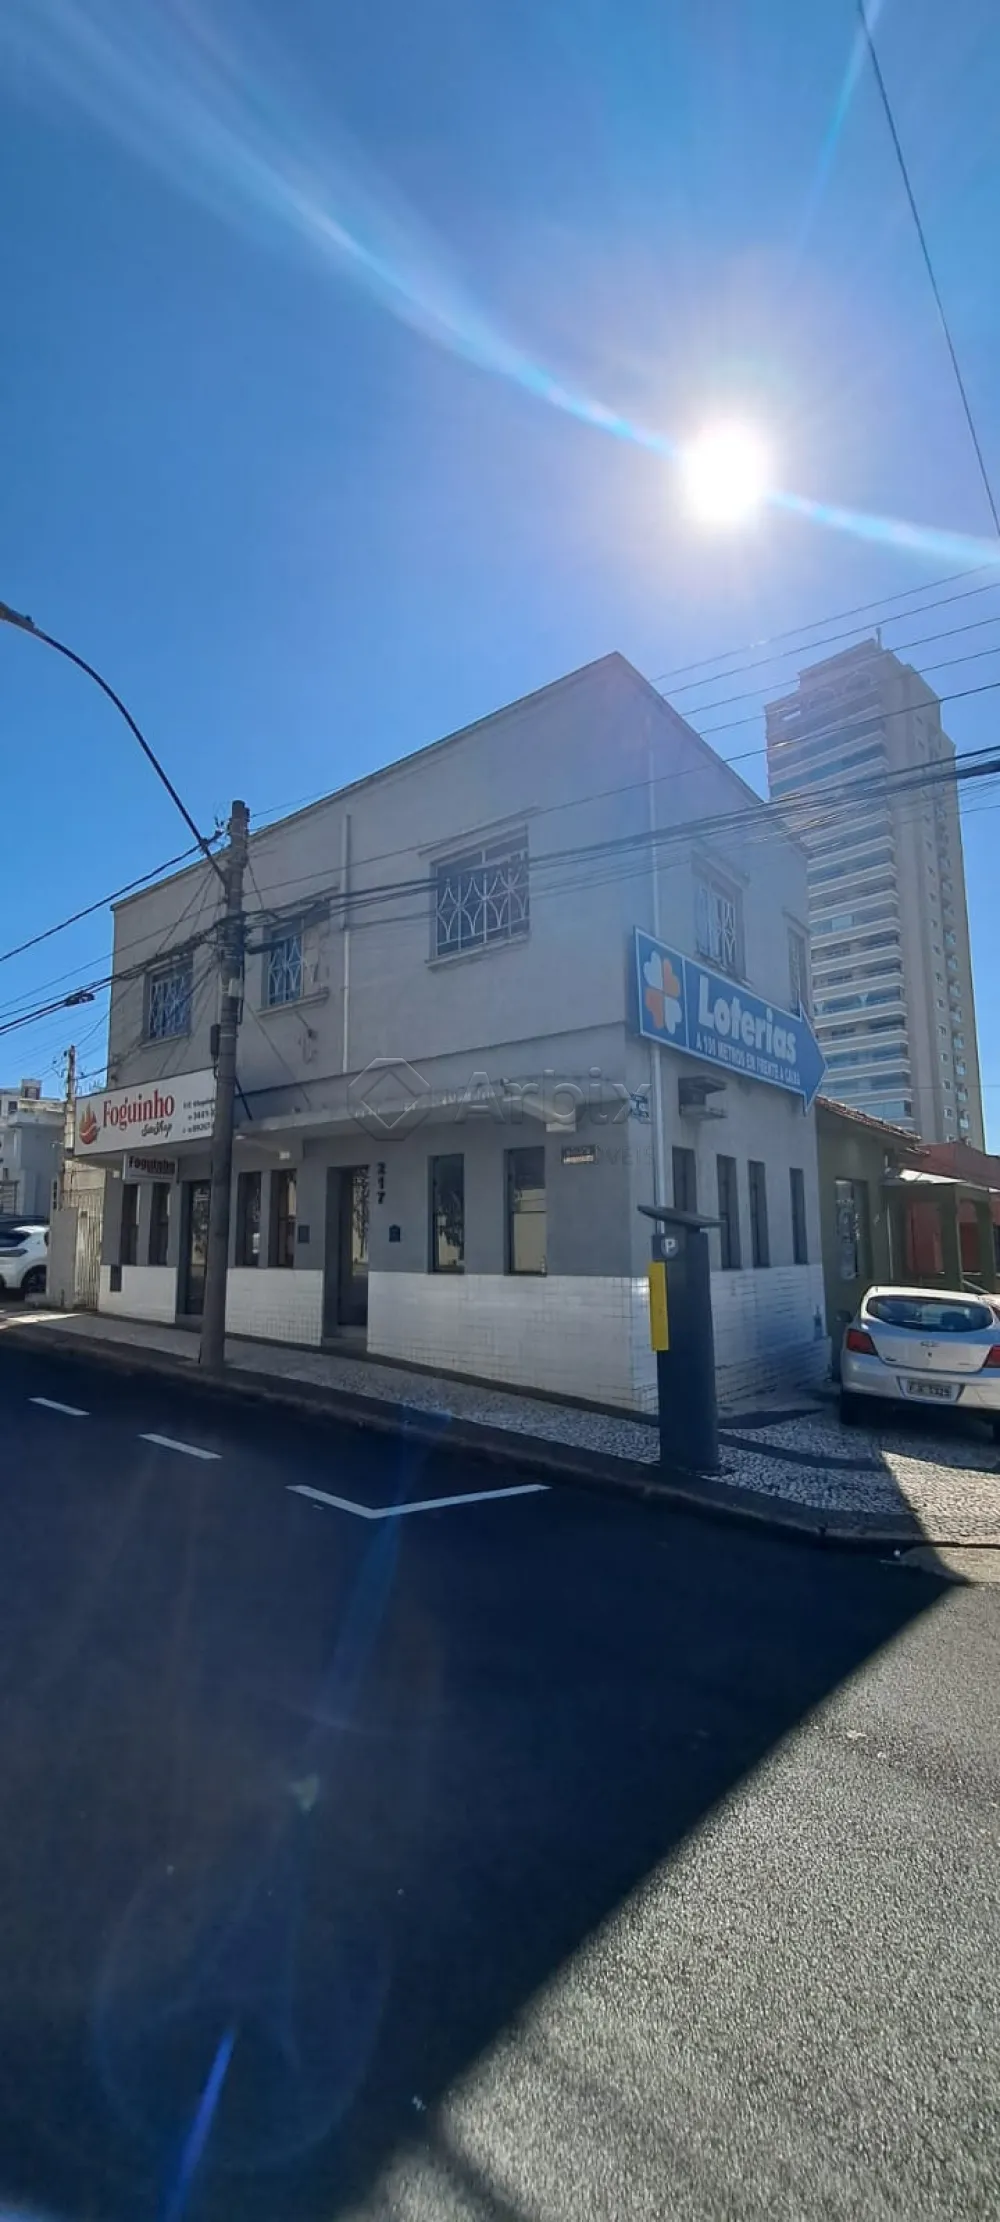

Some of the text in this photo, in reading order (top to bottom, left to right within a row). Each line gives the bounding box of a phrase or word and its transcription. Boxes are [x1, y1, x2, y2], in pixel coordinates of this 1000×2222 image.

[699, 974, 797, 1066] Loterias
[717, 1040, 744, 1068] METROS
[757, 1056, 779, 1080] FRENTE
[103, 1089, 175, 1131] Foguinho
[128, 1155, 176, 1172] Foguinho
[376, 1161, 386, 1204] 217
[665, 1238, 676, 1253] P
